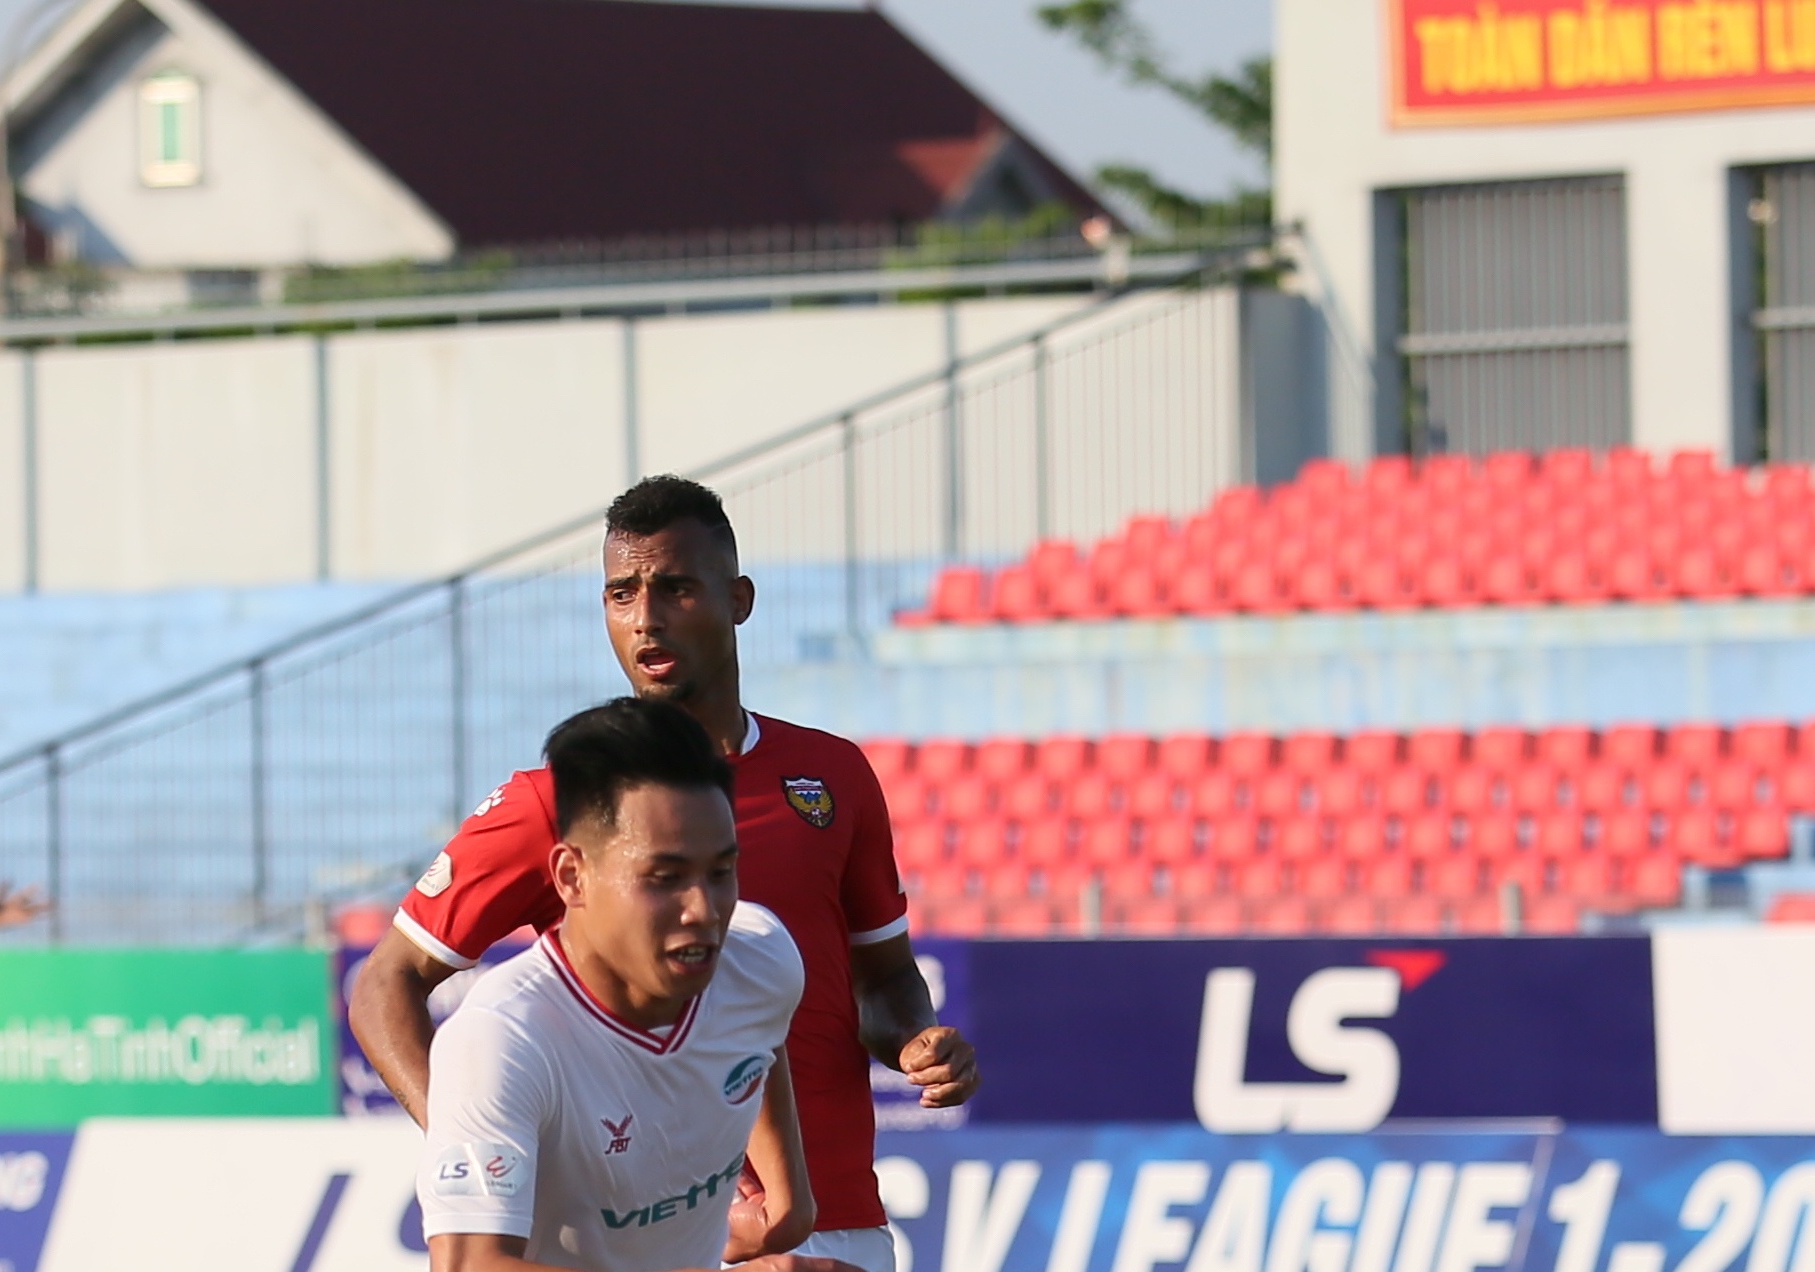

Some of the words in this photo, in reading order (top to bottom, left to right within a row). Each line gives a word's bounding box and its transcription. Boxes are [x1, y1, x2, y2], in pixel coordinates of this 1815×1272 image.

[1193, 966, 1403, 1134] LS
[439, 1162, 470, 1180] LS
[600, 1151, 743, 1229] VIETTE
